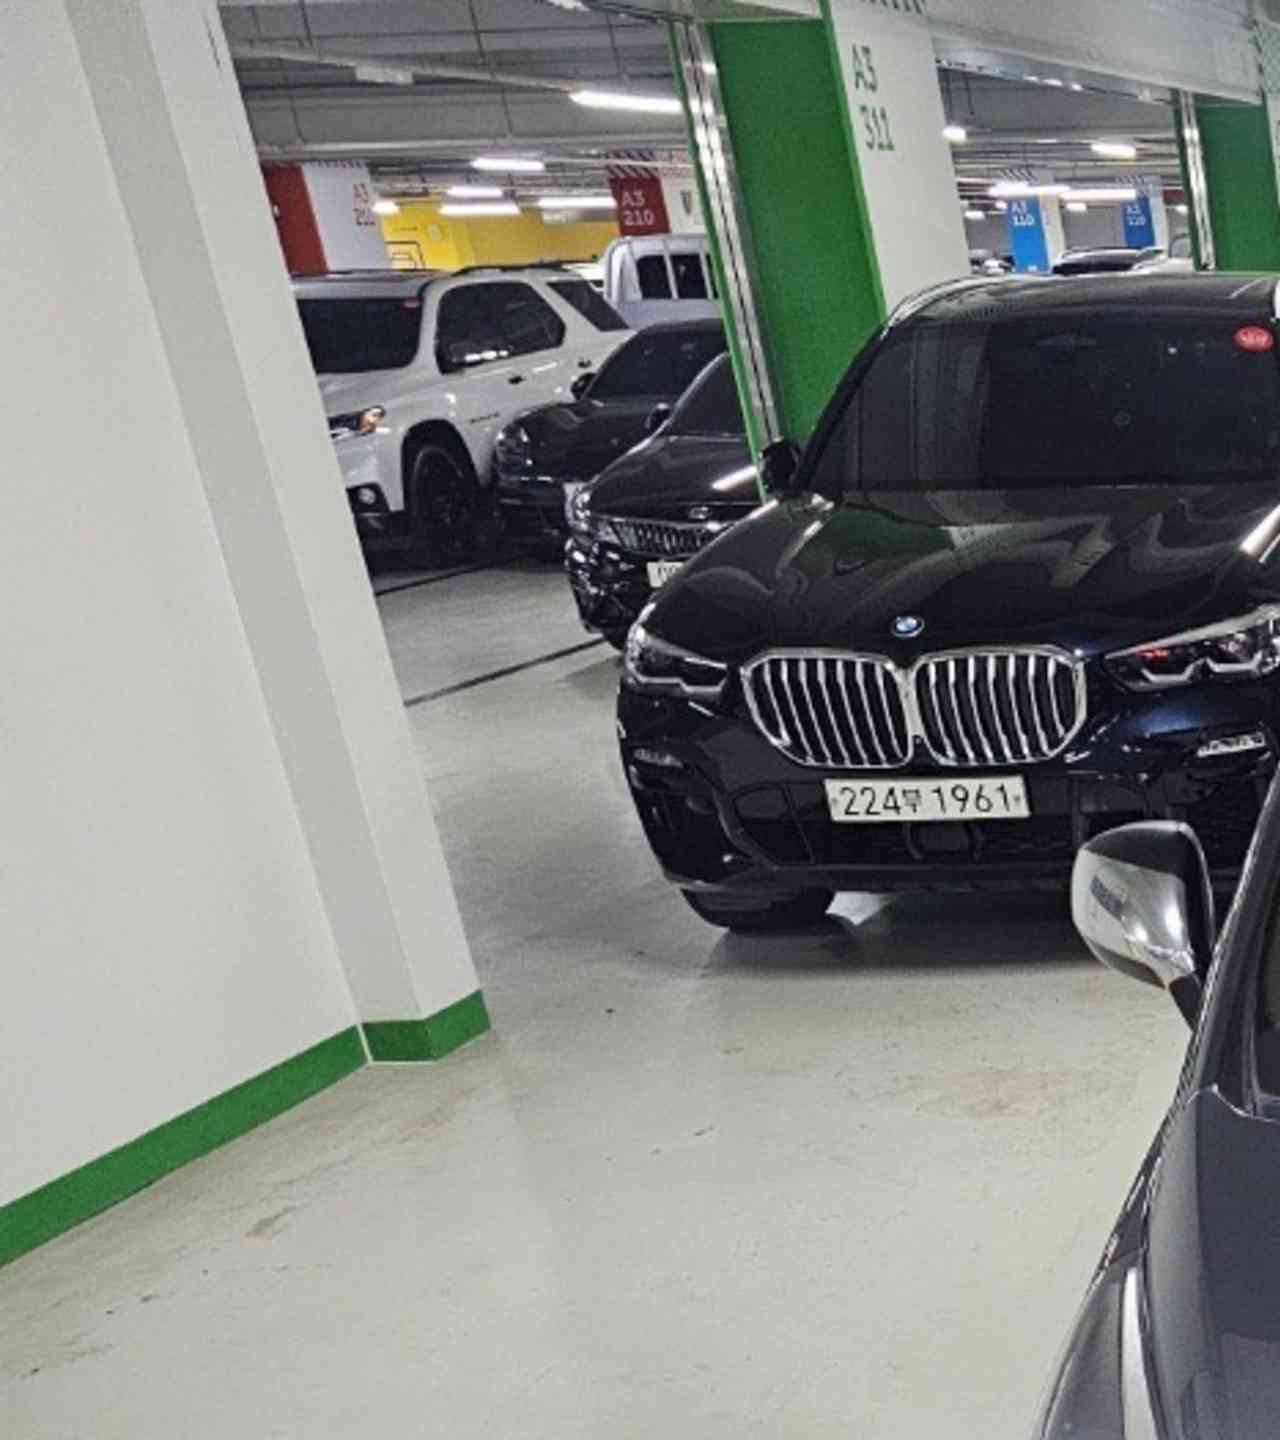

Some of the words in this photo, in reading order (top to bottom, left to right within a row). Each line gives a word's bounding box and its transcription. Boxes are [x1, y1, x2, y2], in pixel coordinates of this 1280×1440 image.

[851, 44, 877, 92] A3
[859, 104, 895, 151] 311
[622, 189, 646, 207] A3
[623, 209, 656, 227] 210
